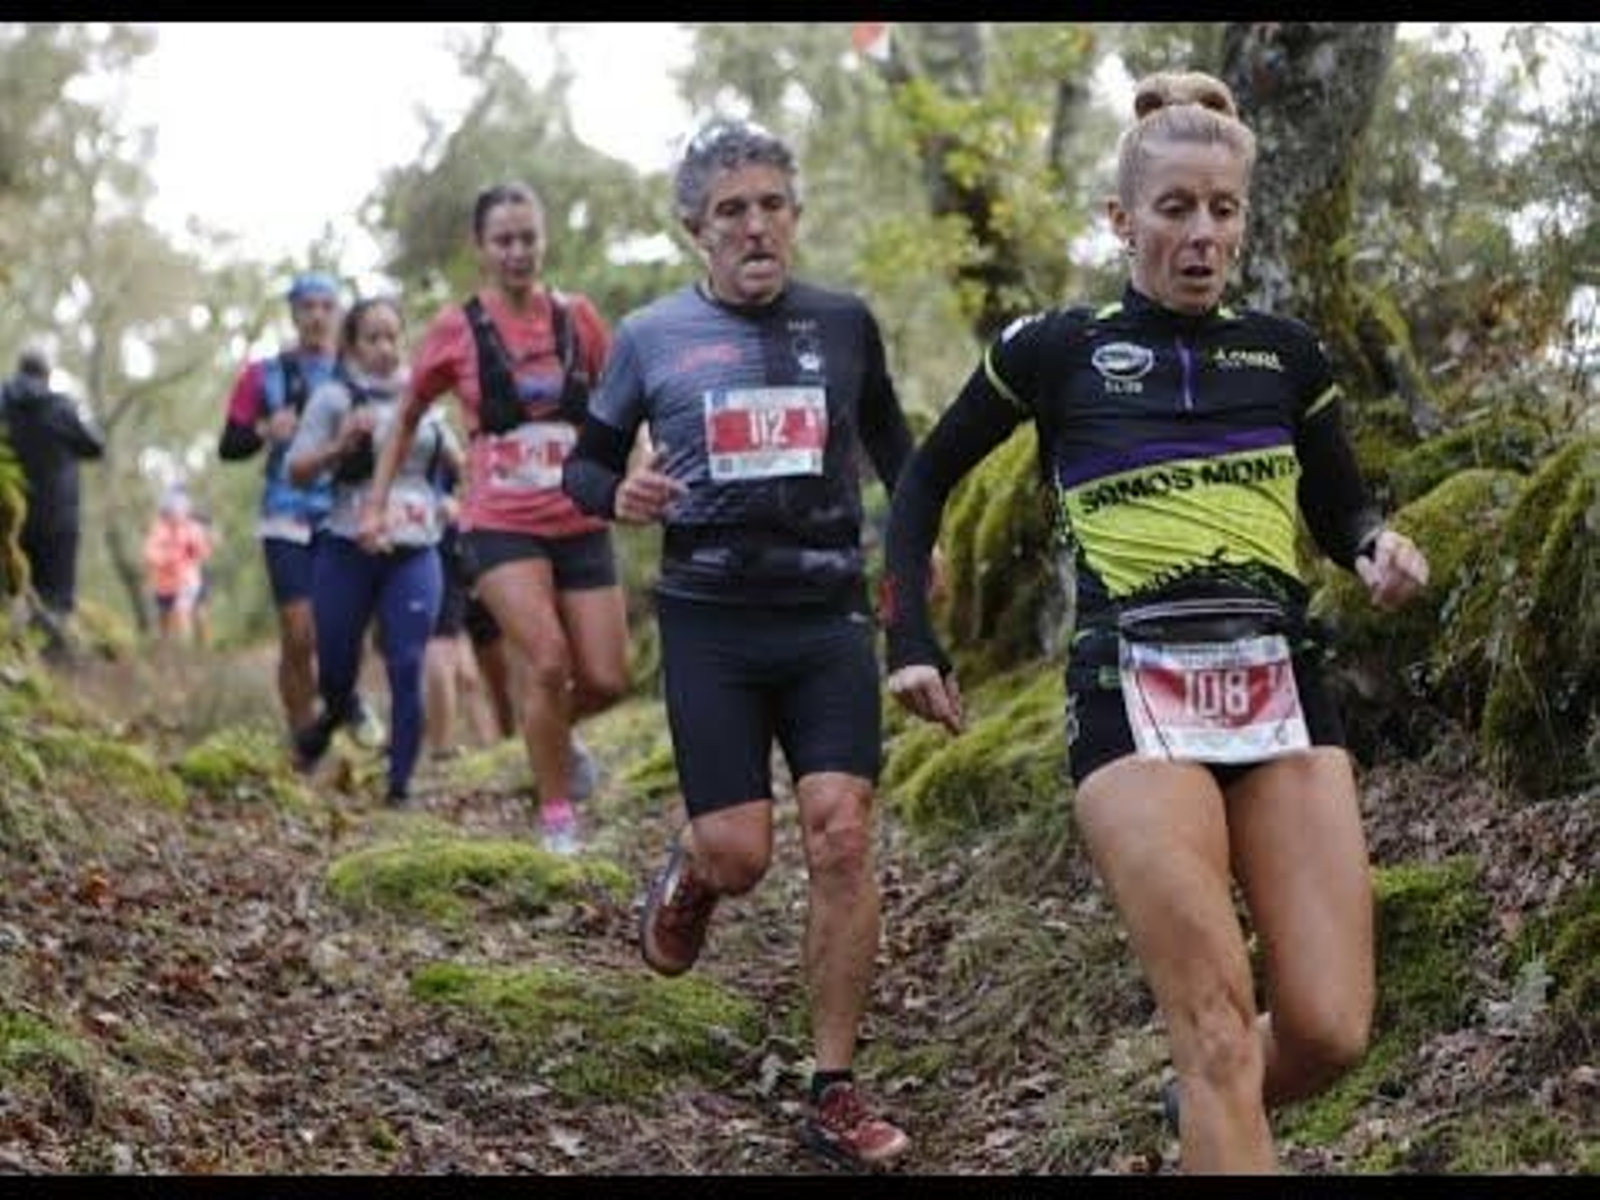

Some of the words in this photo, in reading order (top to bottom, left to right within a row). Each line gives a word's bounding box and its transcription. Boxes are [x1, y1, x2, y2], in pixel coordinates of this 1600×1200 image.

[748, 408, 789, 443] 112
[1079, 467, 1195, 514] SOMOS
[1183, 670, 1250, 716] 108
